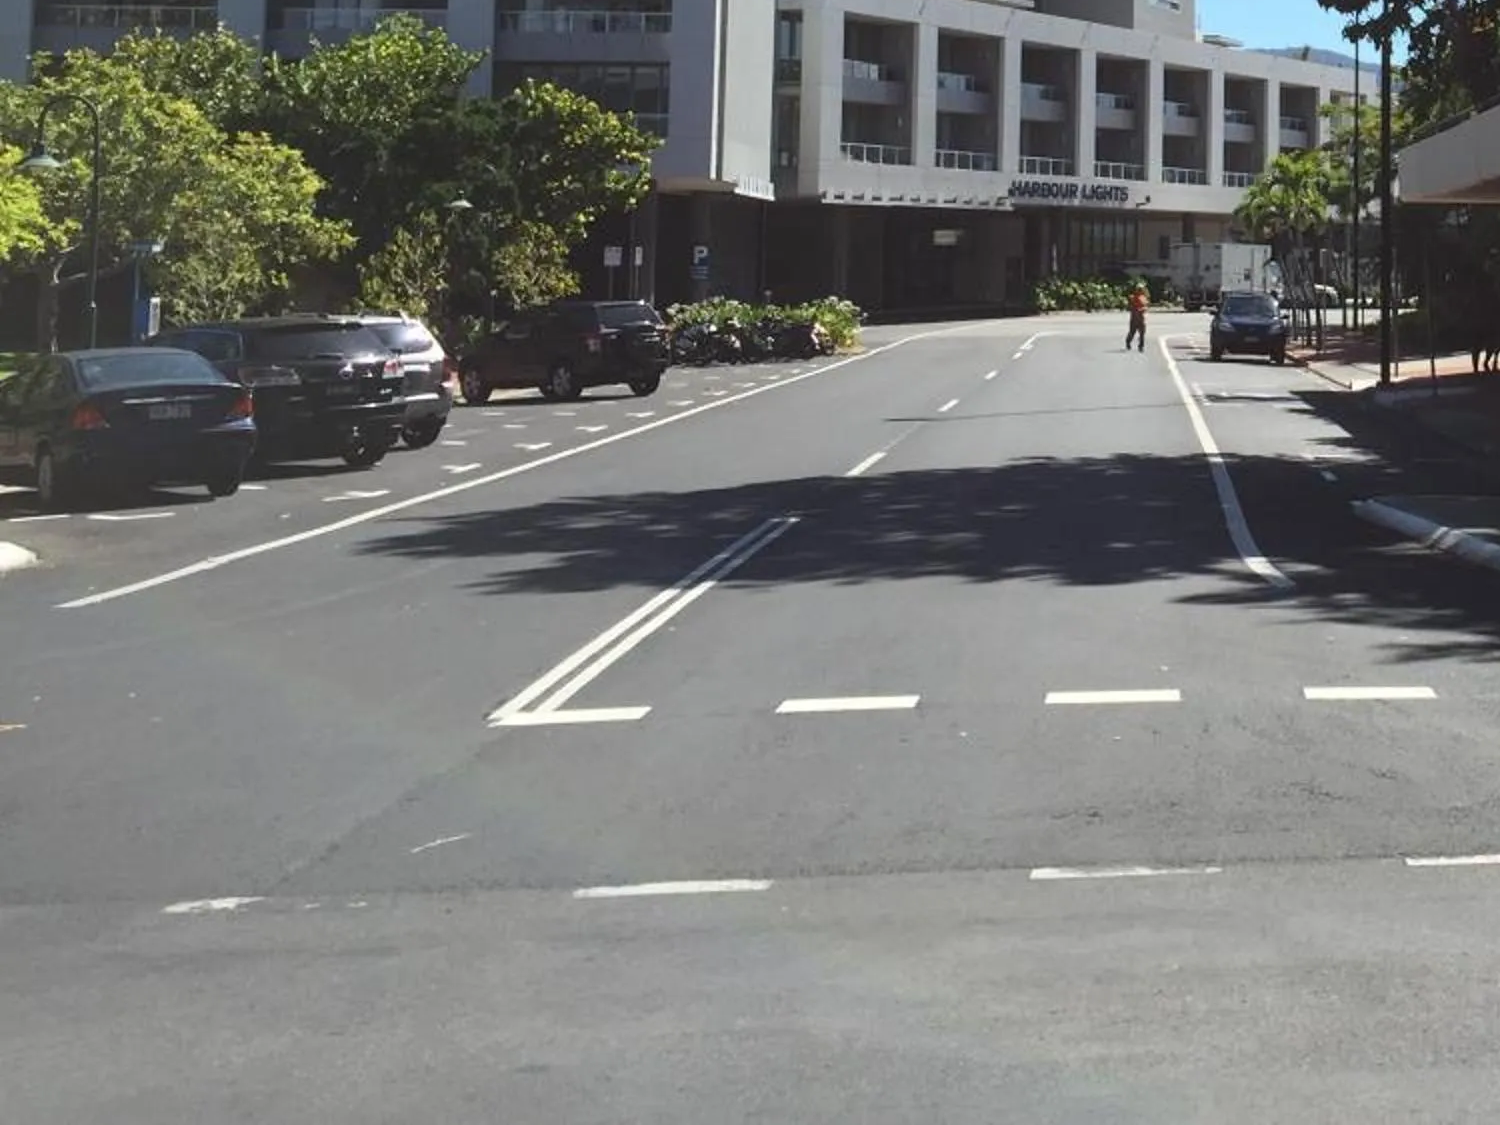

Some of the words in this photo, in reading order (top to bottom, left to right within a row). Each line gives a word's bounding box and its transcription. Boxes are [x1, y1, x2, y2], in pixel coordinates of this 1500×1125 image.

[1009, 179, 1079, 199] HARBOUR
[1079, 183, 1129, 203] LIGHTS
[692, 245, 709, 265] P
